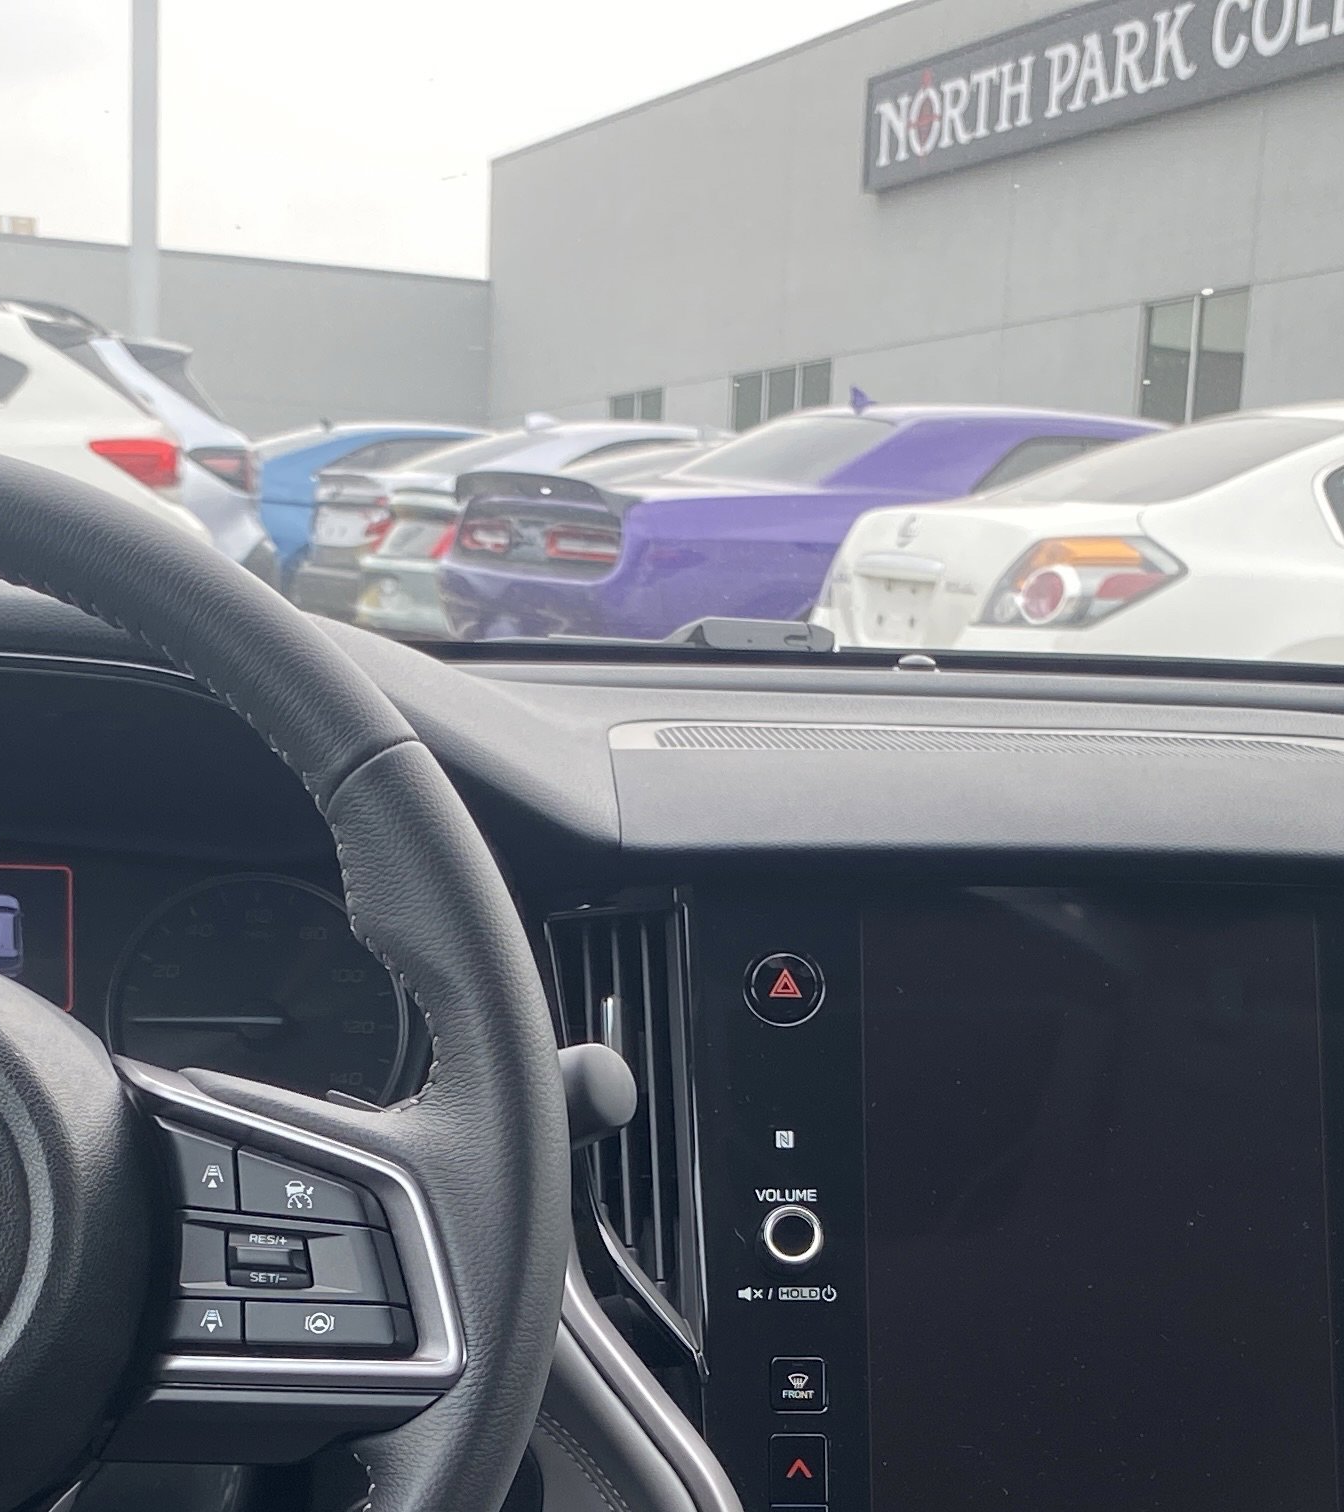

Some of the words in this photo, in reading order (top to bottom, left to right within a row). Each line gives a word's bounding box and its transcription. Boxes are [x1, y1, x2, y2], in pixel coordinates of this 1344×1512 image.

[874, 56, 1035, 167] NORTH
[1044, 2, 1197, 118] PARK
[755, 1188, 818, 1202] VOLUME
[779, 1288, 819, 1300] HOLD
[782, 1389, 815, 1399] FRONT
